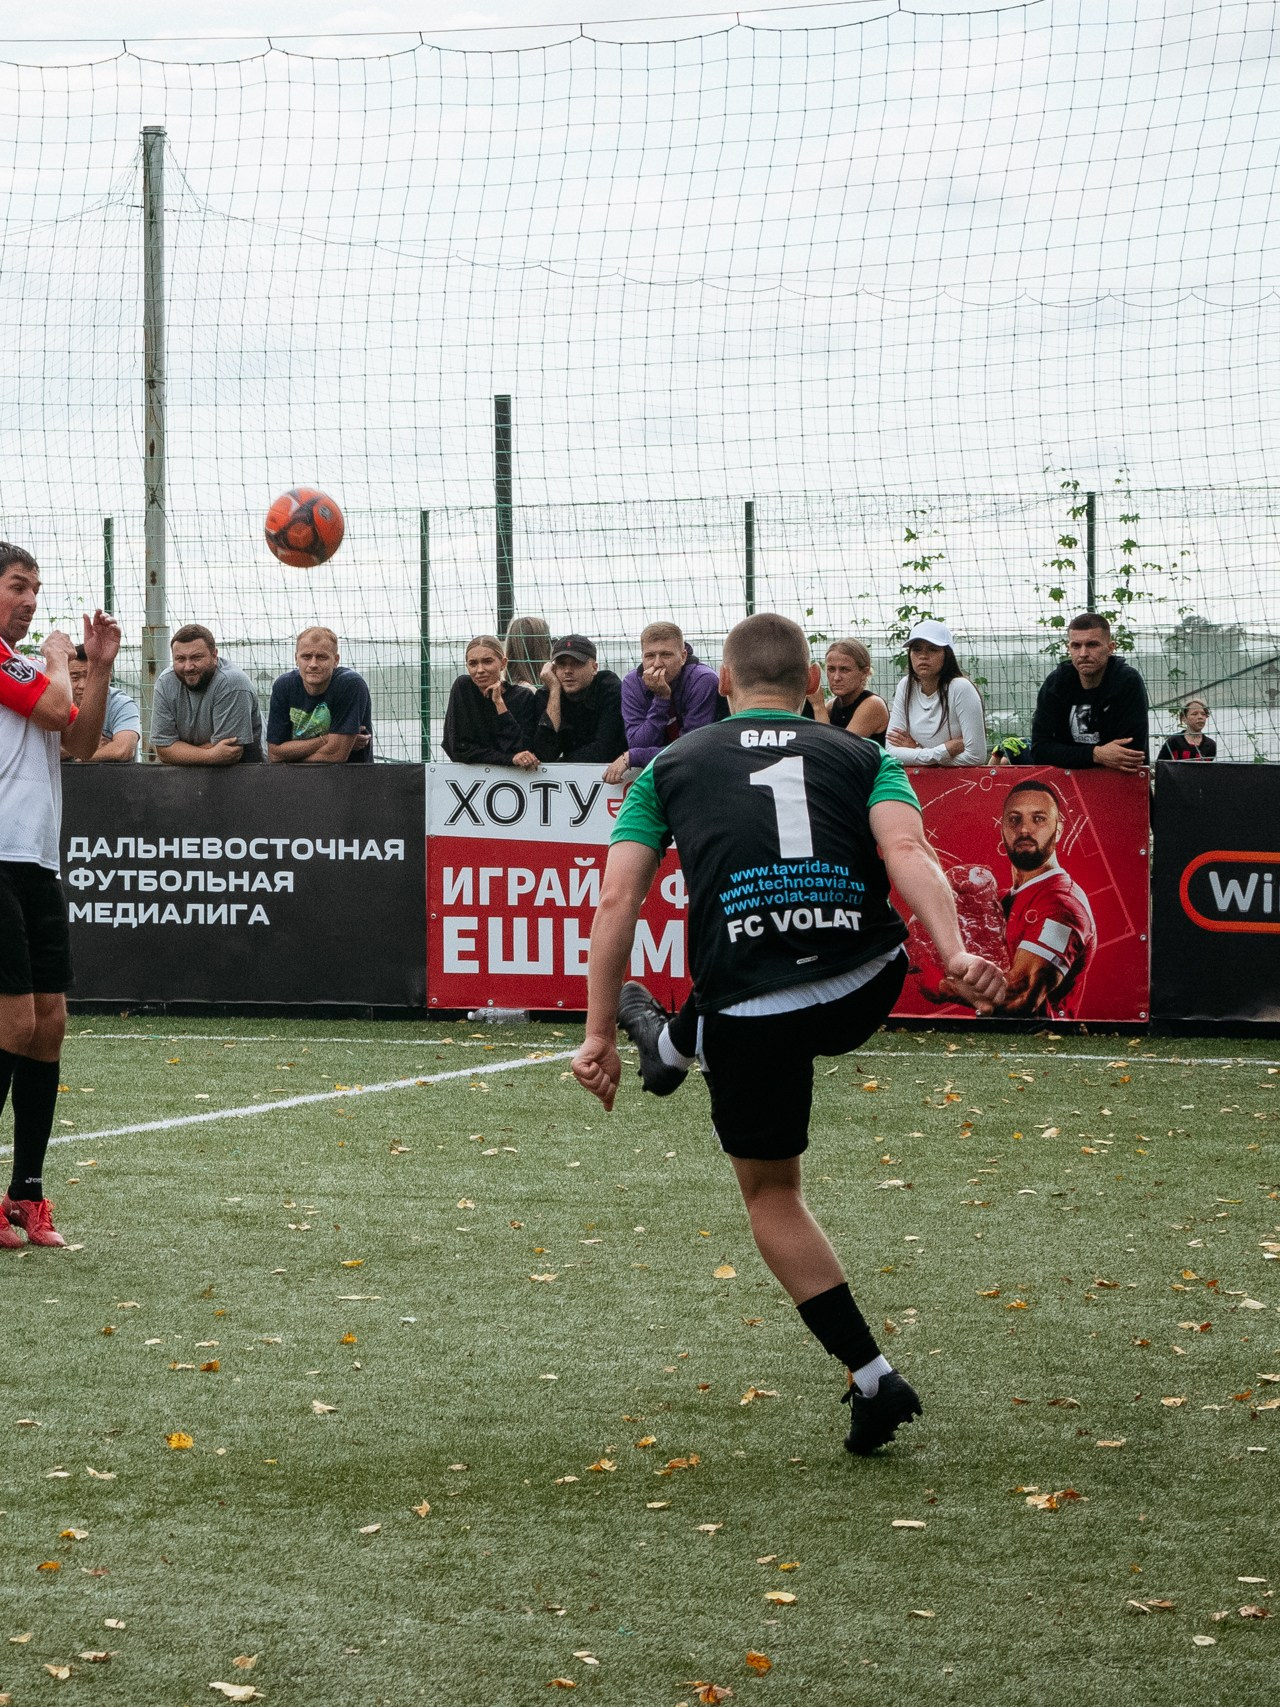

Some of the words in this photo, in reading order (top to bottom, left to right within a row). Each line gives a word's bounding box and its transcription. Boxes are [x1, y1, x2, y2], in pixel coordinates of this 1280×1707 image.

[740, 729, 797, 748] GAP
[444, 779, 605, 828] ХОТУ
[749, 755, 814, 859] 1
[67, 836, 405, 862] ДАЛЬНЕВОСТОЧНАЯ
[68, 867, 295, 893] ФУТБОЛЬНАЯ
[442, 857, 601, 907] ИГРАЙ
[730, 861, 849, 883] www.tavrida.ru
[719, 876, 865, 903] www.technoavia.ru
[1209, 871, 1280, 914] Wi
[68, 902, 271, 928] МЕДИАЛИГА
[727, 915, 765, 943] FC
[770, 908, 862, 932] VOLAT
